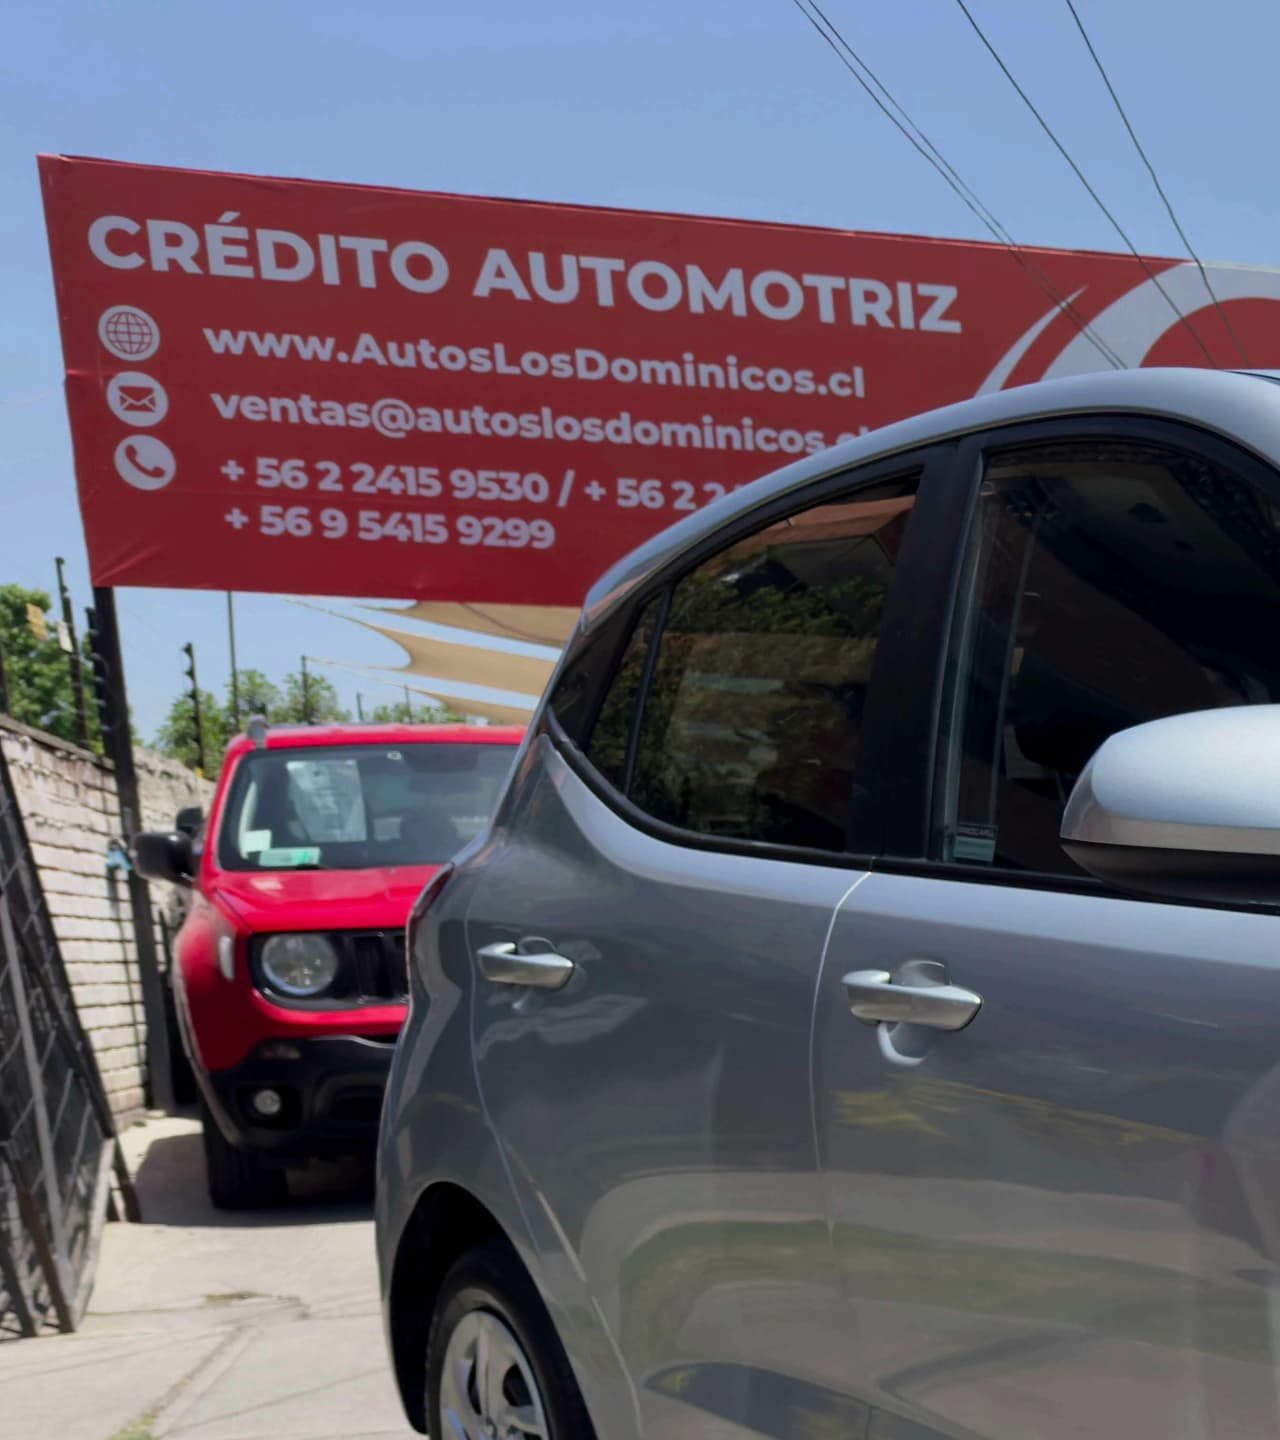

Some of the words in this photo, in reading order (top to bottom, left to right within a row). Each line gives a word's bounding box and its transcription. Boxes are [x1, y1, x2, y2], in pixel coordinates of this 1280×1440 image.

[88, 212, 449, 293] CRÉDITO
[473, 249, 962, 334] AUTOMOTRIZ
[202, 327, 865, 398] www.AutosLosDominicos.cl
[256, 458, 308, 489] 56
[317, 462, 343, 491] 2
[351, 463, 443, 499] 2415
[448, 469, 549, 504] 9530
[616, 477, 664, 510] 56
[671, 480, 696, 510] 2
[260, 507, 312, 536] 56
[320, 509, 348, 539] 9
[357, 510, 448, 543] 5415
[458, 516, 554, 549] 9299
